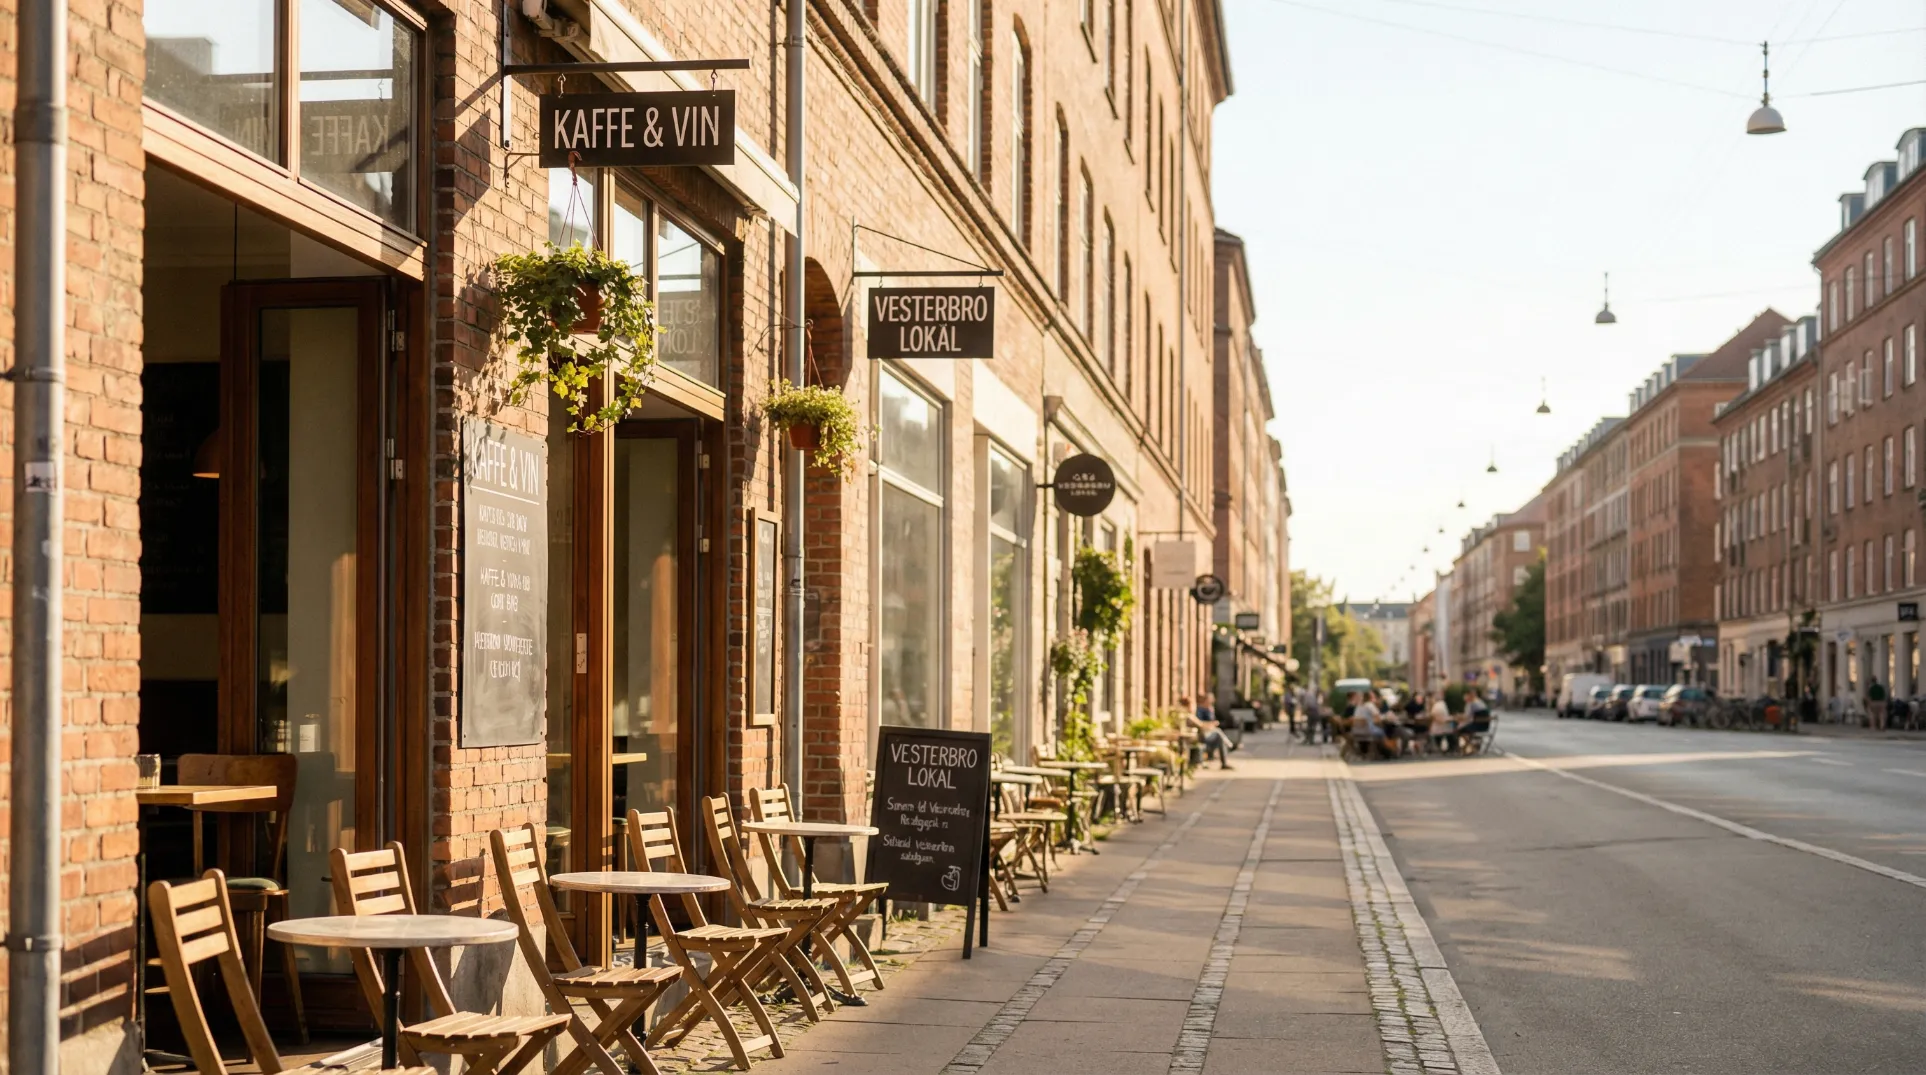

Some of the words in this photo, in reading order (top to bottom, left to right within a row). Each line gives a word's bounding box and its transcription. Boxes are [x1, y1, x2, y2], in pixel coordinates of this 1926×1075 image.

[554, 107, 635, 149] KAFFE
[643, 106, 664, 148] &
[672, 105, 720, 147] VIN
[874, 295, 988, 322] VESTERBRO
[471, 435, 507, 488] KAFFE
[509, 446, 518, 491] &
[520, 449, 539, 496] VIN
[890, 743, 978, 769] VESTERBRO
[907, 766, 957, 790] LOKAL
